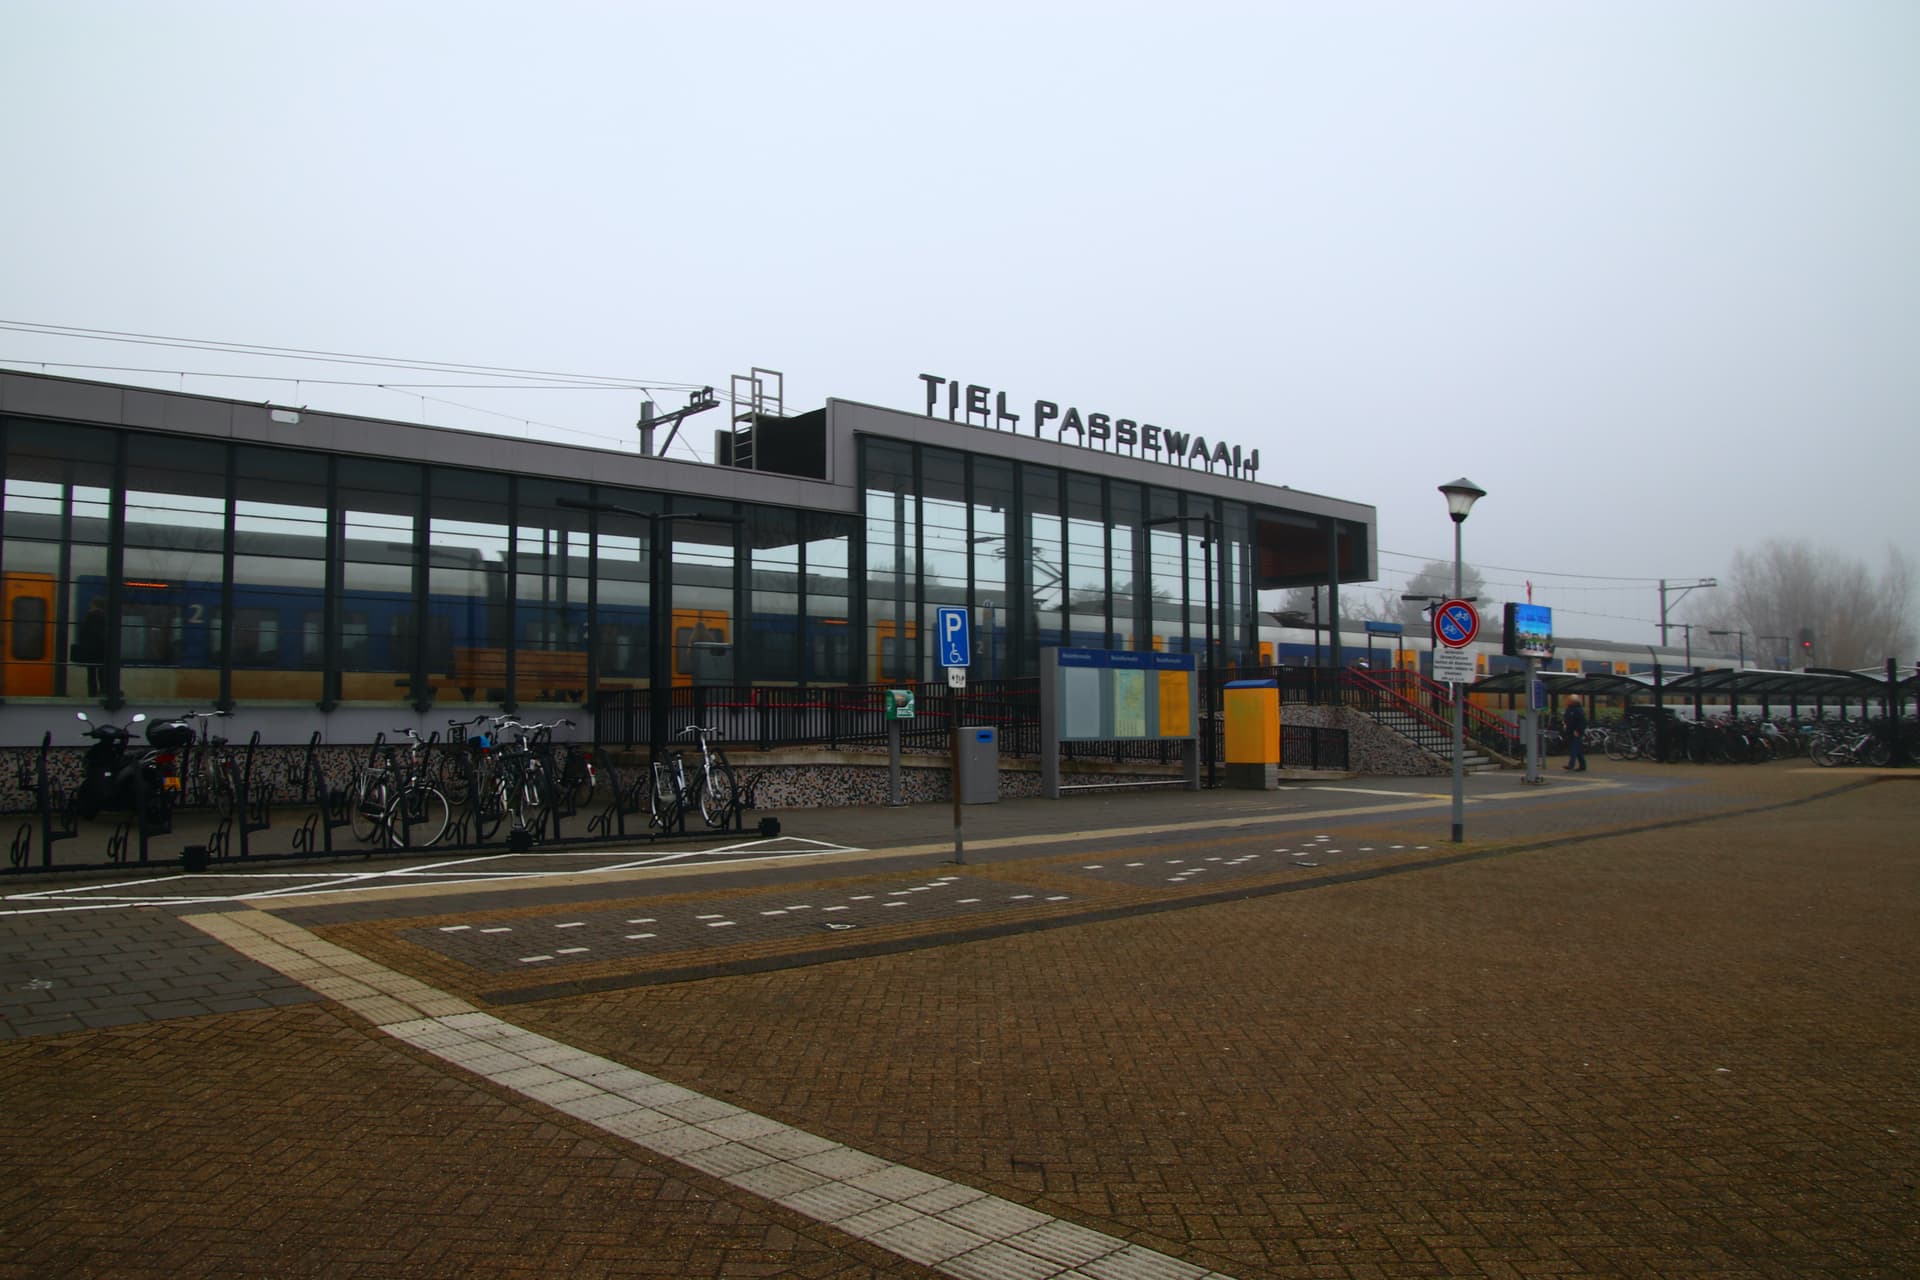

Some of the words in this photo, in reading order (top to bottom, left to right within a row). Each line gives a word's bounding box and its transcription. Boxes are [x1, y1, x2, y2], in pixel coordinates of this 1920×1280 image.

[919, 373, 1020, 422] TIEL
[1034, 400, 1260, 471] PASSEWAAIJ
[188, 604, 205, 623] 2
[945, 613, 962, 642] P
